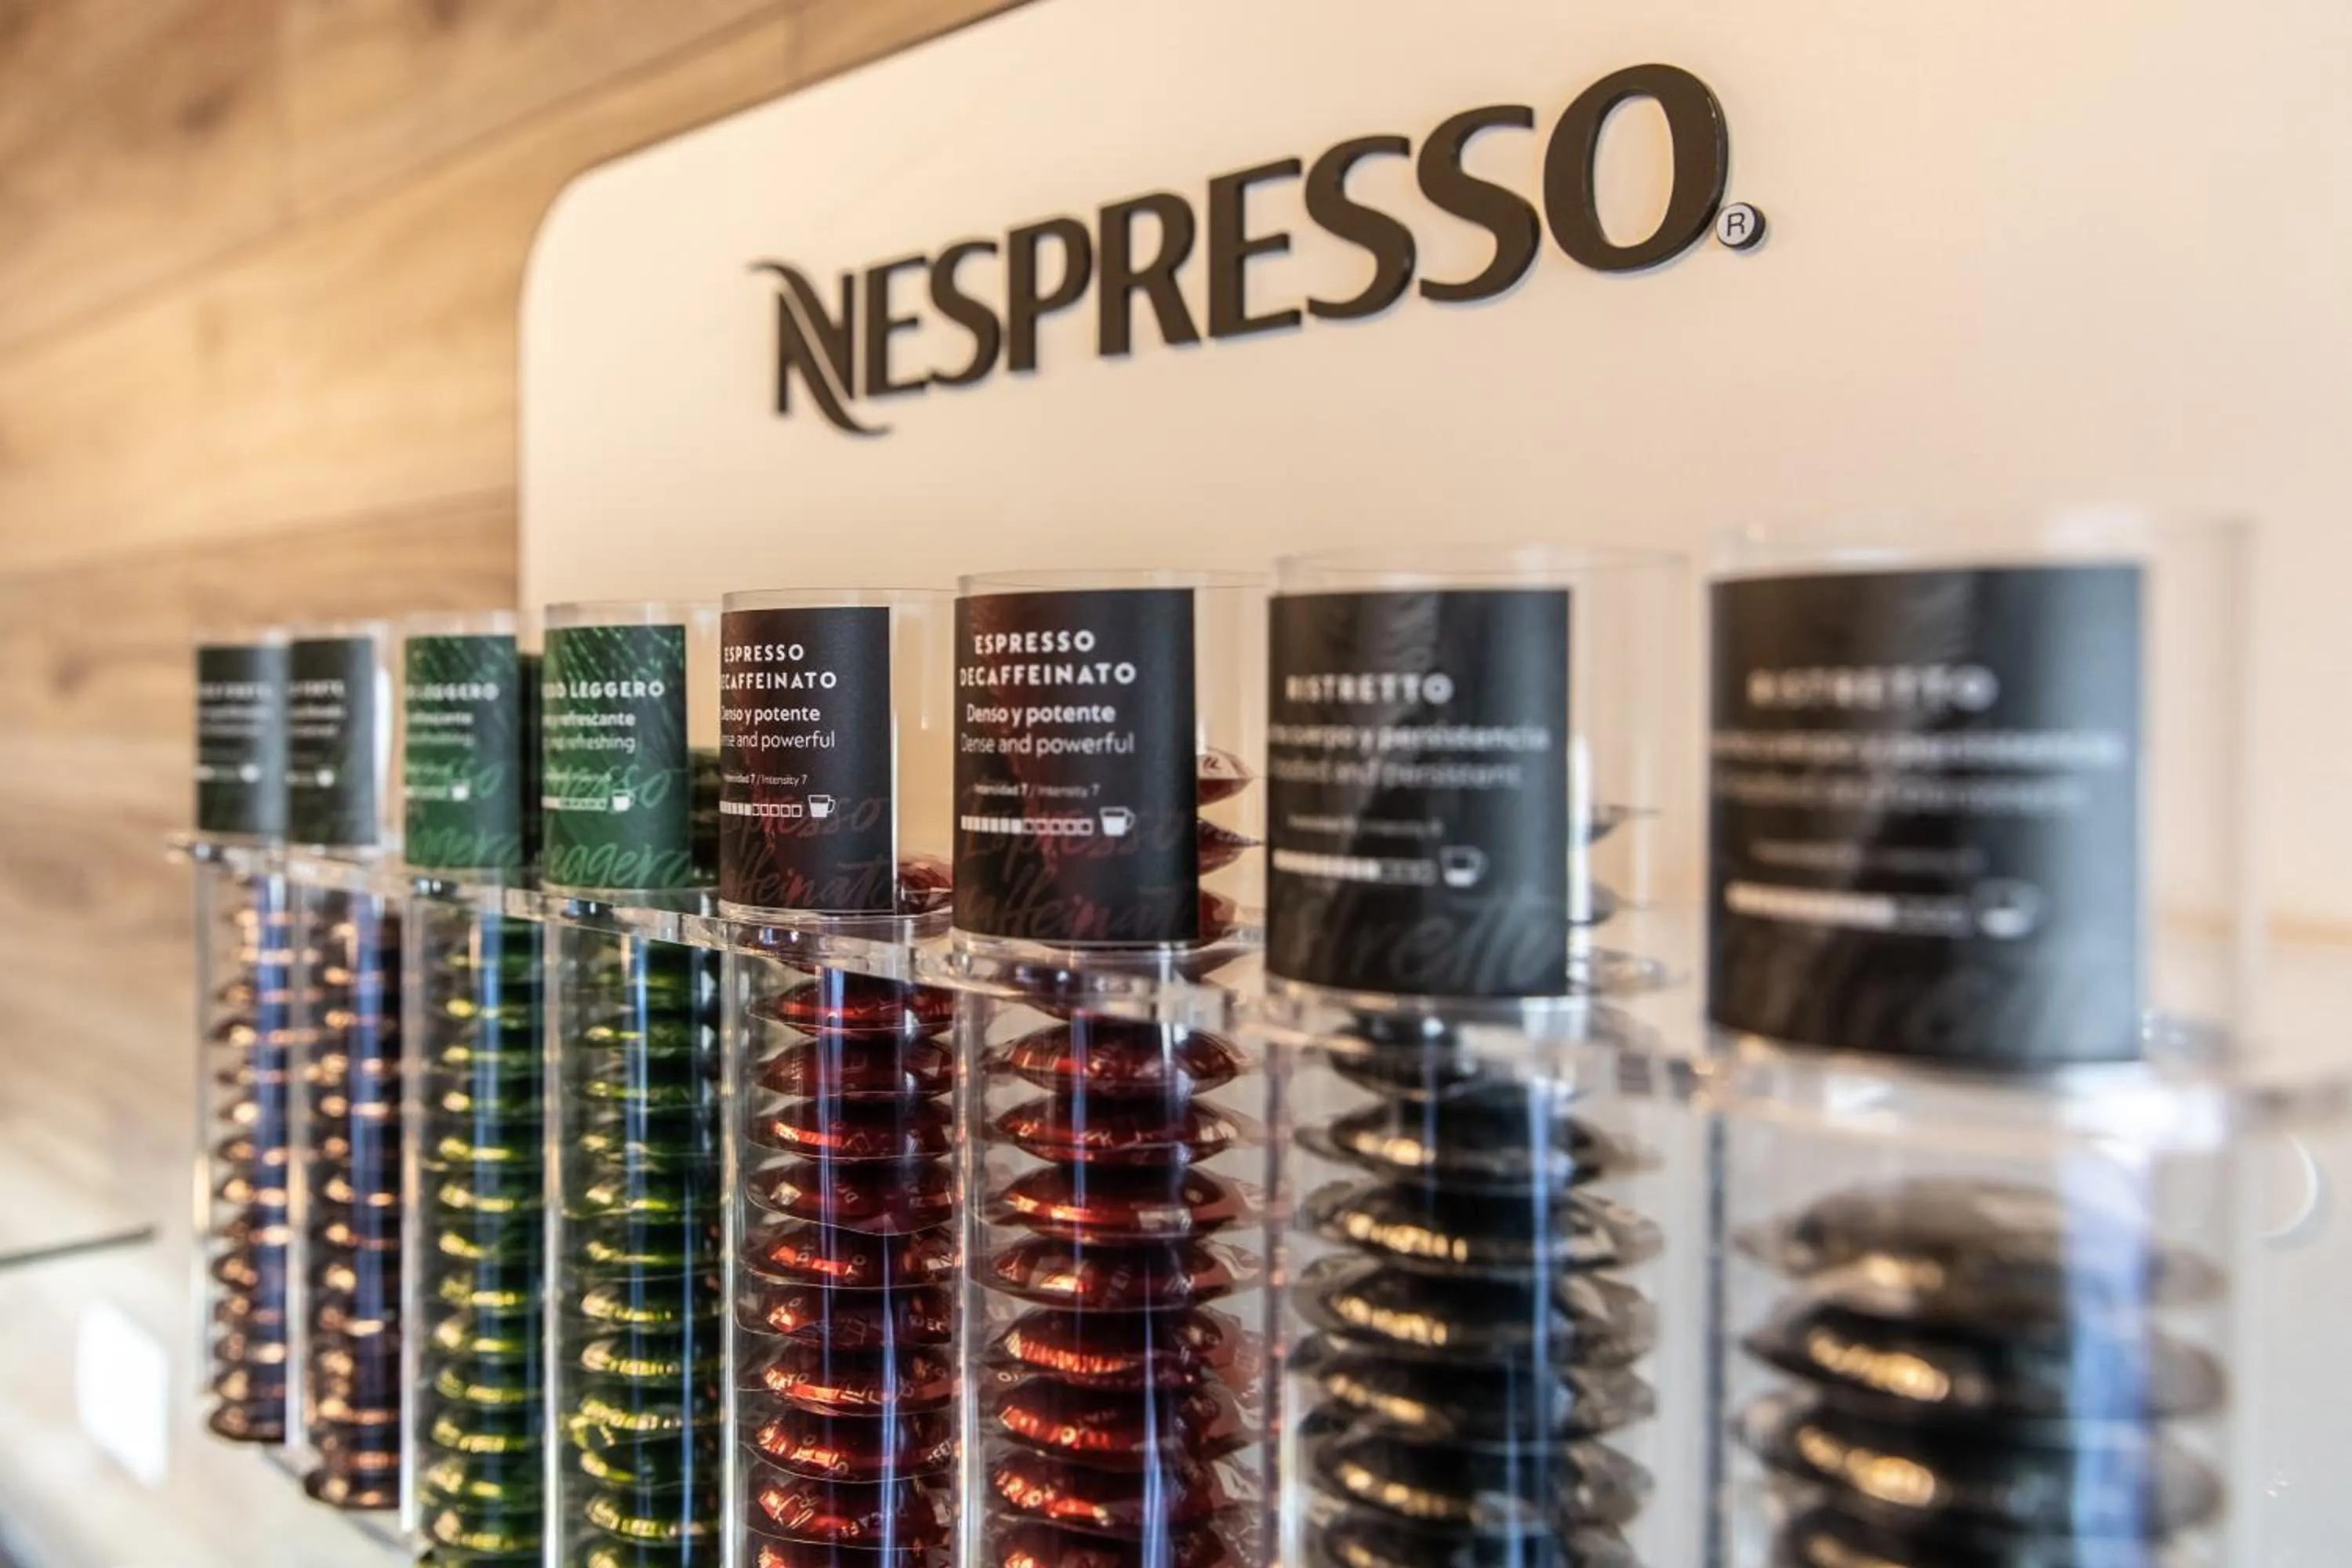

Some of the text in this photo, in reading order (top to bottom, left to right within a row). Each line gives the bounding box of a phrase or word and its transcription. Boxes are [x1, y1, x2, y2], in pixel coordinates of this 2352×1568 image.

[748, 63, 1730, 436] NESPRESSO
[724, 643, 804, 662] ESPRESSO
[975, 630, 1095, 655] ESPRESSO
[720, 671, 837, 690] ECAFFEINATO
[960, 662, 1137, 687] DECAFFEINATO
[569, 680, 666, 699] LEGGERO
[744, 708, 752, 726] y
[754, 707, 821, 726] potente
[966, 703, 1117, 728] Denso y potente
[736, 731, 758, 748] and
[760, 730, 836, 753] powerful
[960, 731, 1135, 759] Dense and powerful
